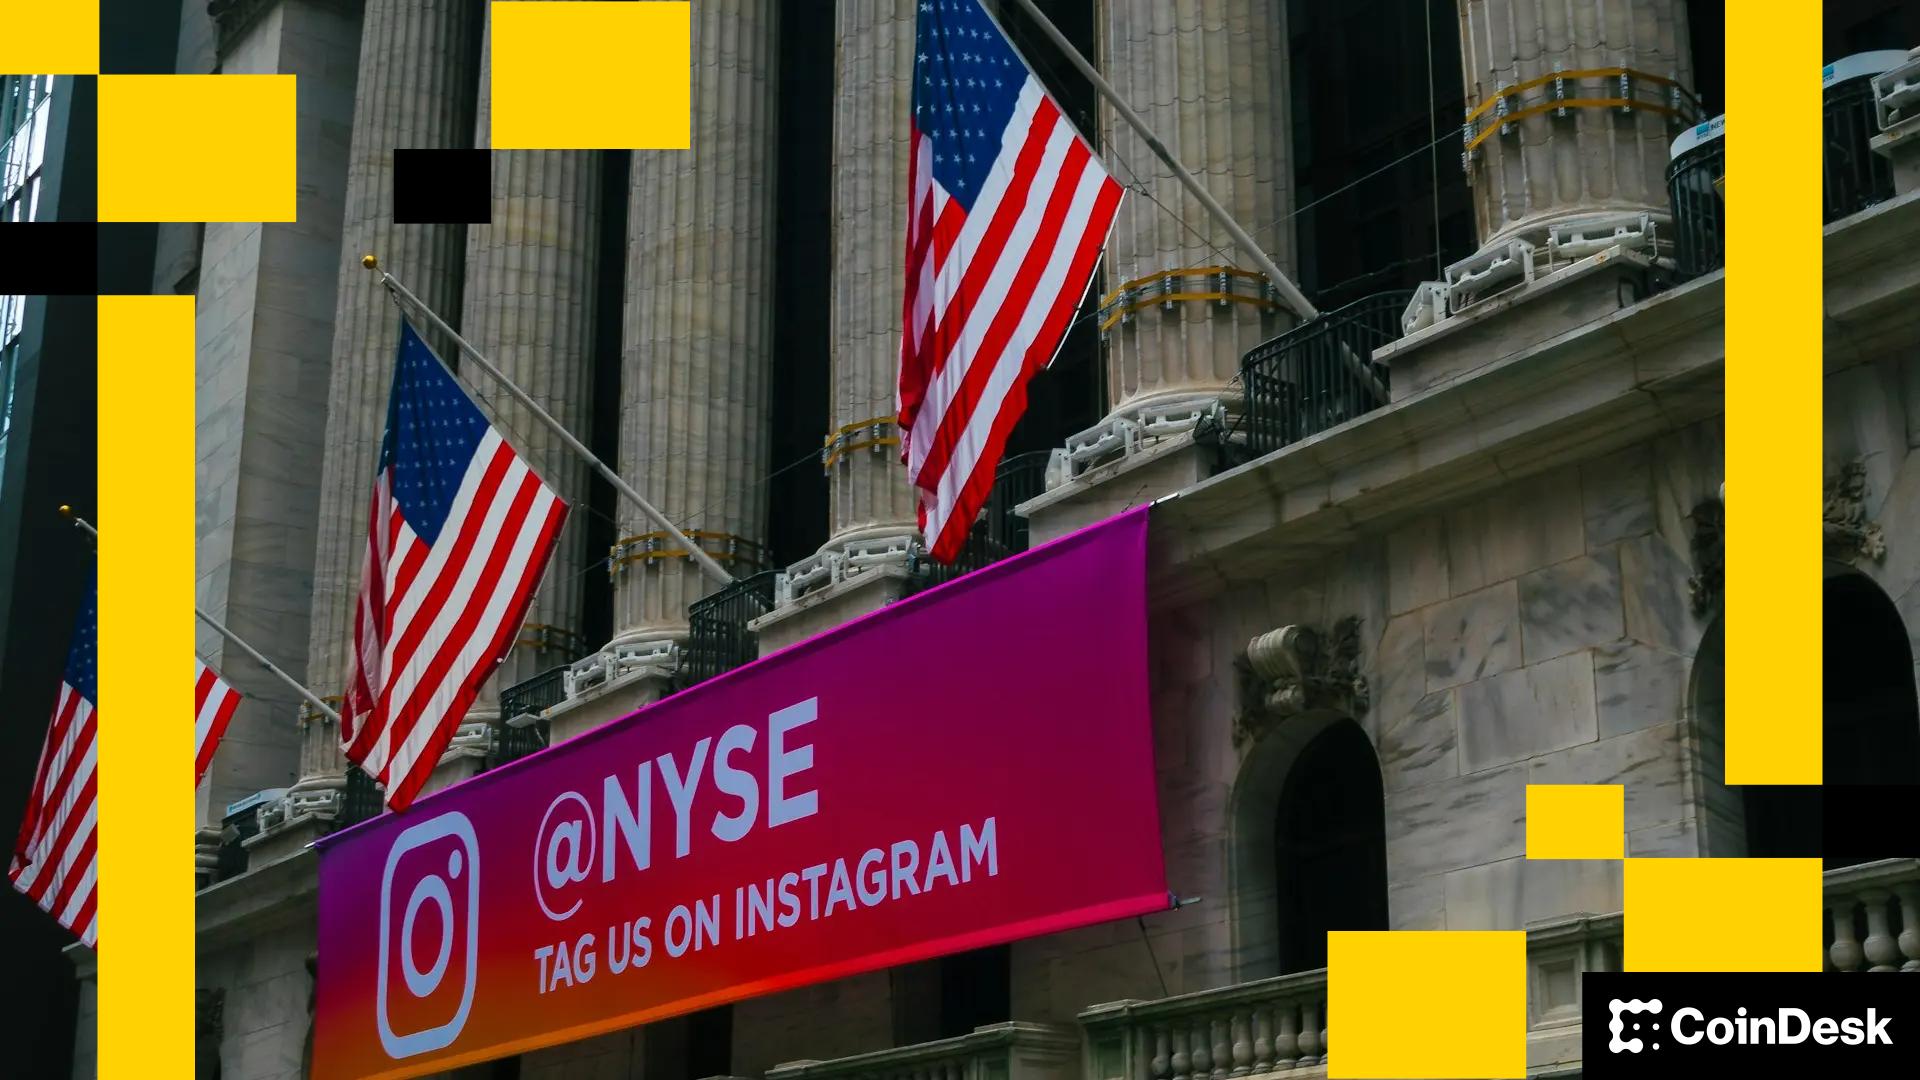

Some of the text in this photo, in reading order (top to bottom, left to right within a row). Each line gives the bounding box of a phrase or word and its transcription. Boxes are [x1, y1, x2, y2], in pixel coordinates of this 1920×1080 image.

[534, 696, 818, 921] @NYSE
[534, 816, 998, 994] TAG US ON INSTAGRAM
